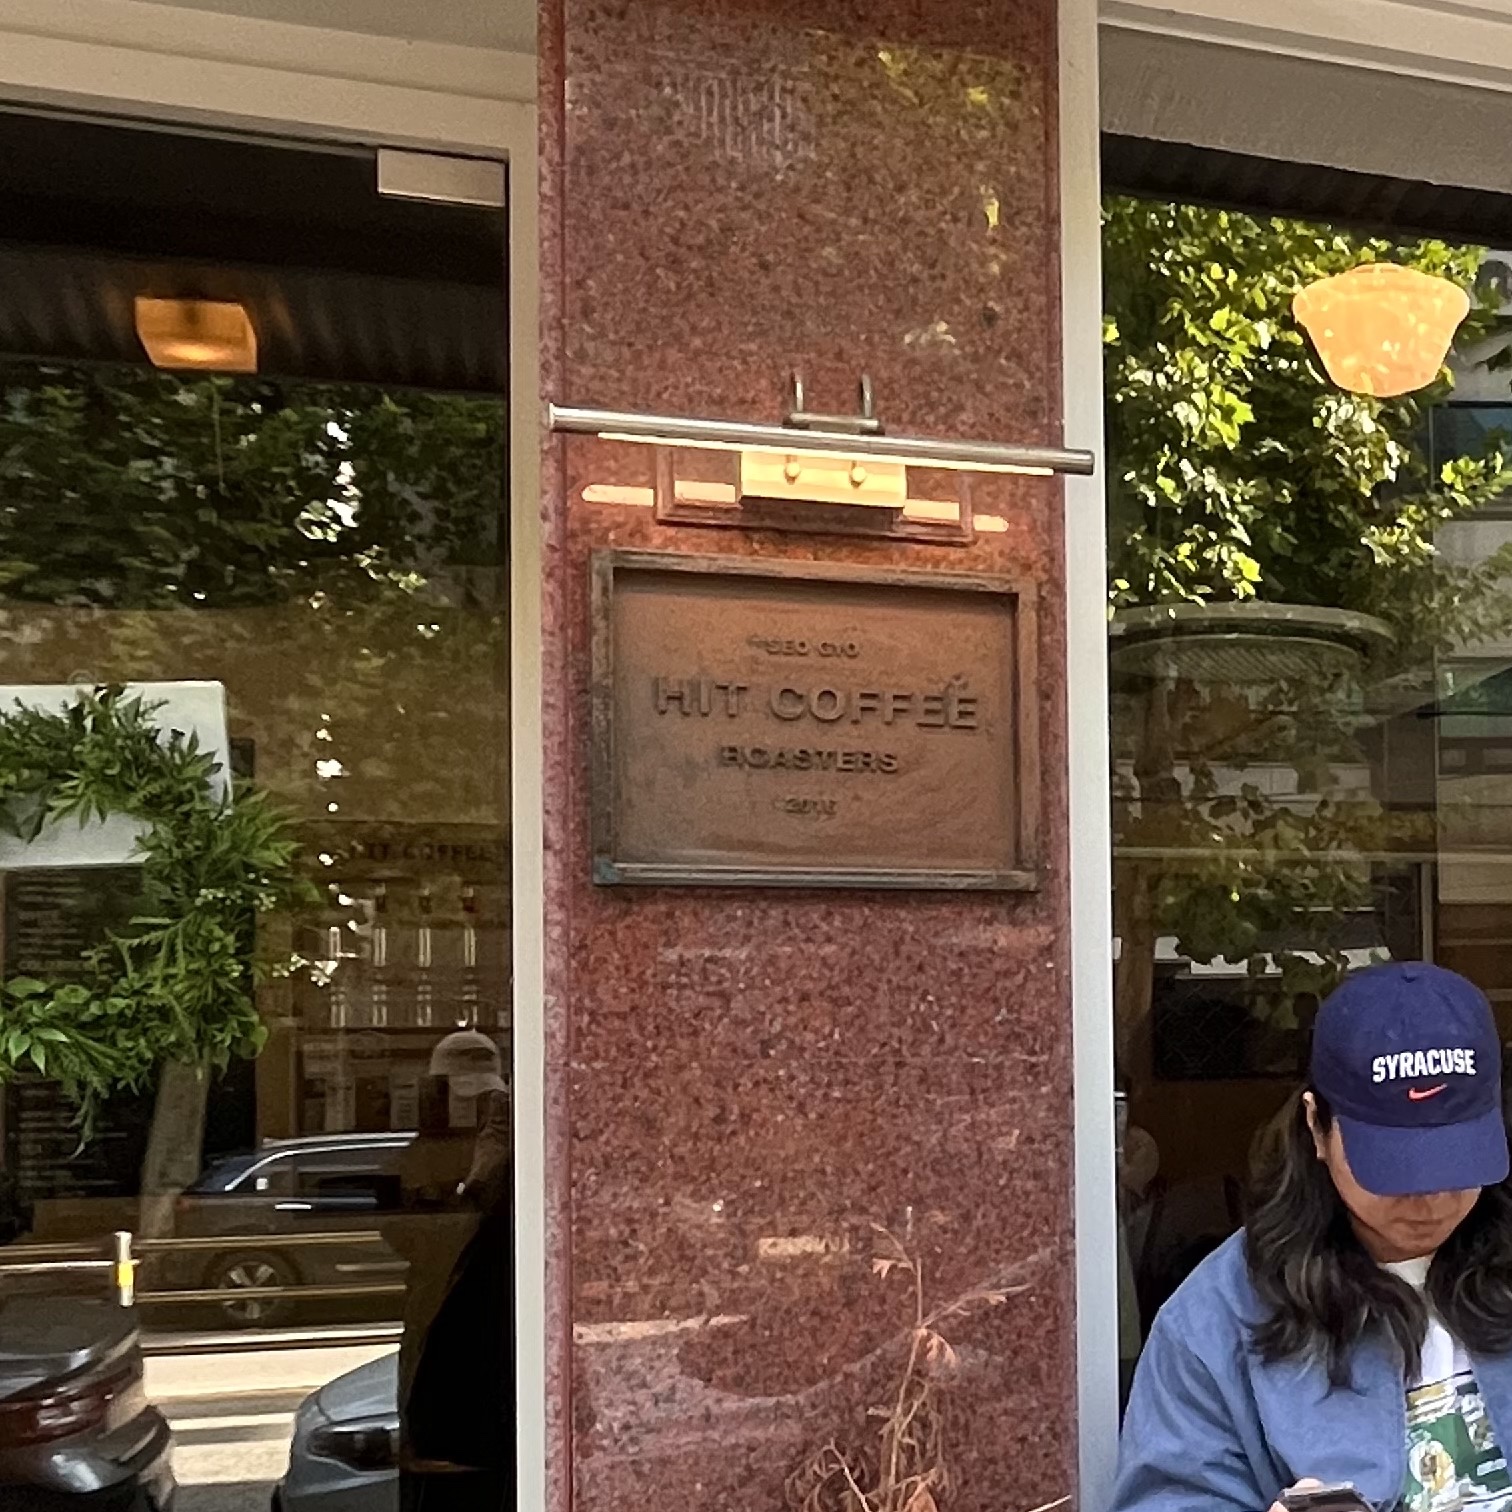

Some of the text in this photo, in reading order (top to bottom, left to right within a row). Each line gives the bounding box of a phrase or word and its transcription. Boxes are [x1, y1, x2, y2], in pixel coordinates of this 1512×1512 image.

[655, 677, 749, 719] HIT
[719, 746, 899, 774] ROASTERS
[1372, 1048, 1477, 1083] SYRACUSE
